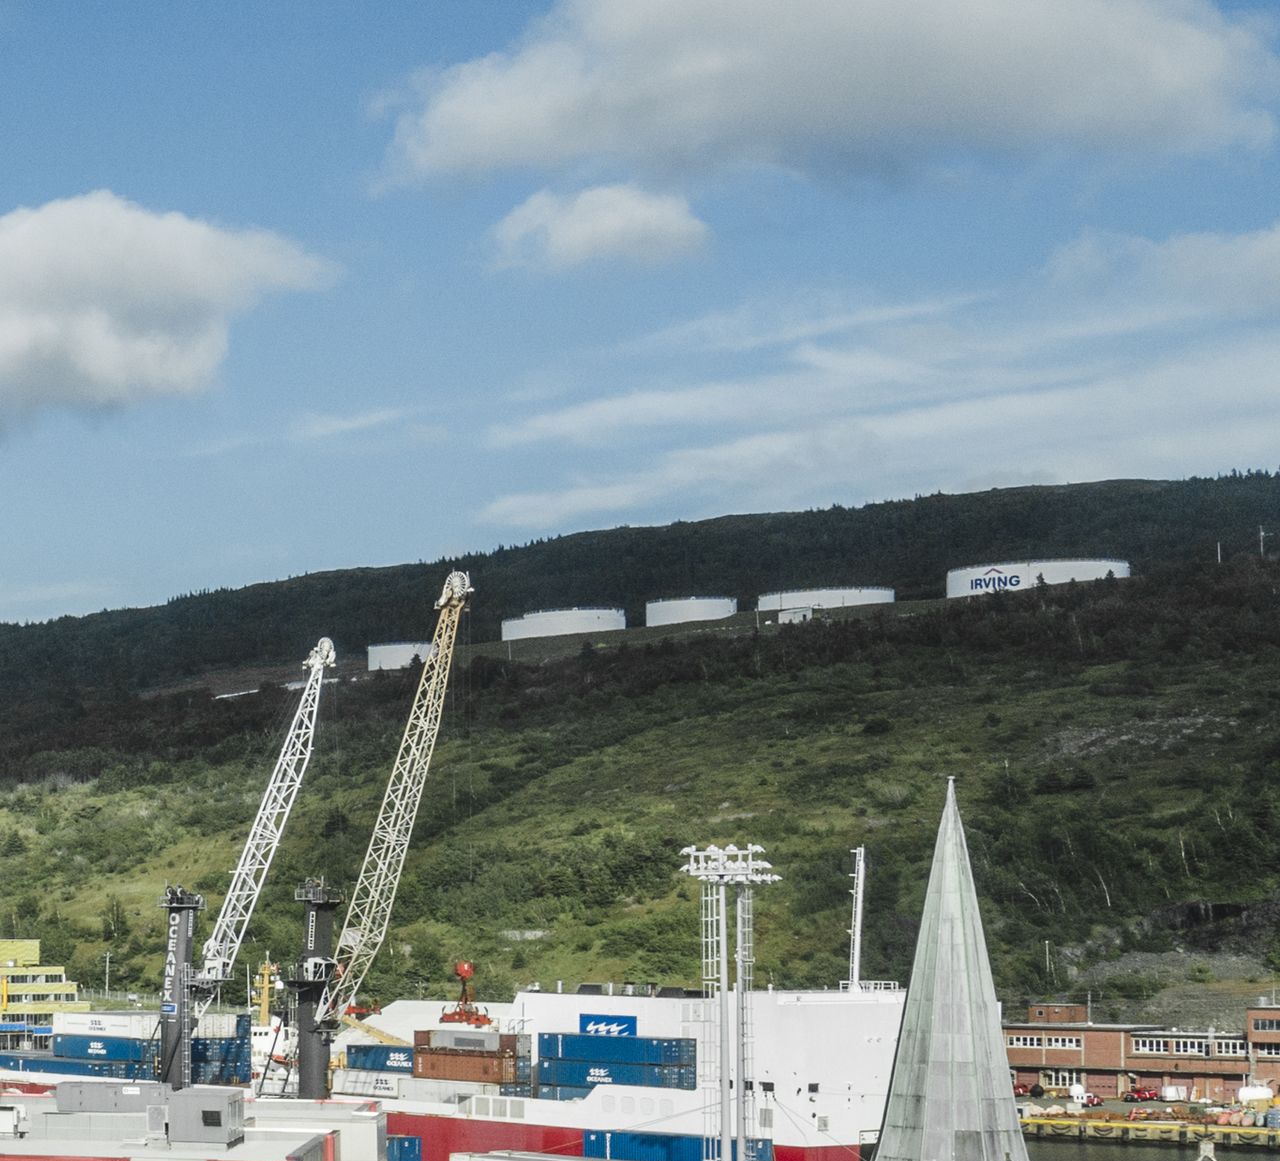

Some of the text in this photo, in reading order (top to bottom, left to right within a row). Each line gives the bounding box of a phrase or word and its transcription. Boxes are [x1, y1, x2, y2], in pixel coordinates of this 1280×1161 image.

[970, 574, 1021, 591] IRVING
[163, 913, 180, 1001] OCEANEX
[386, 1060, 412, 1068] OCEANEX
